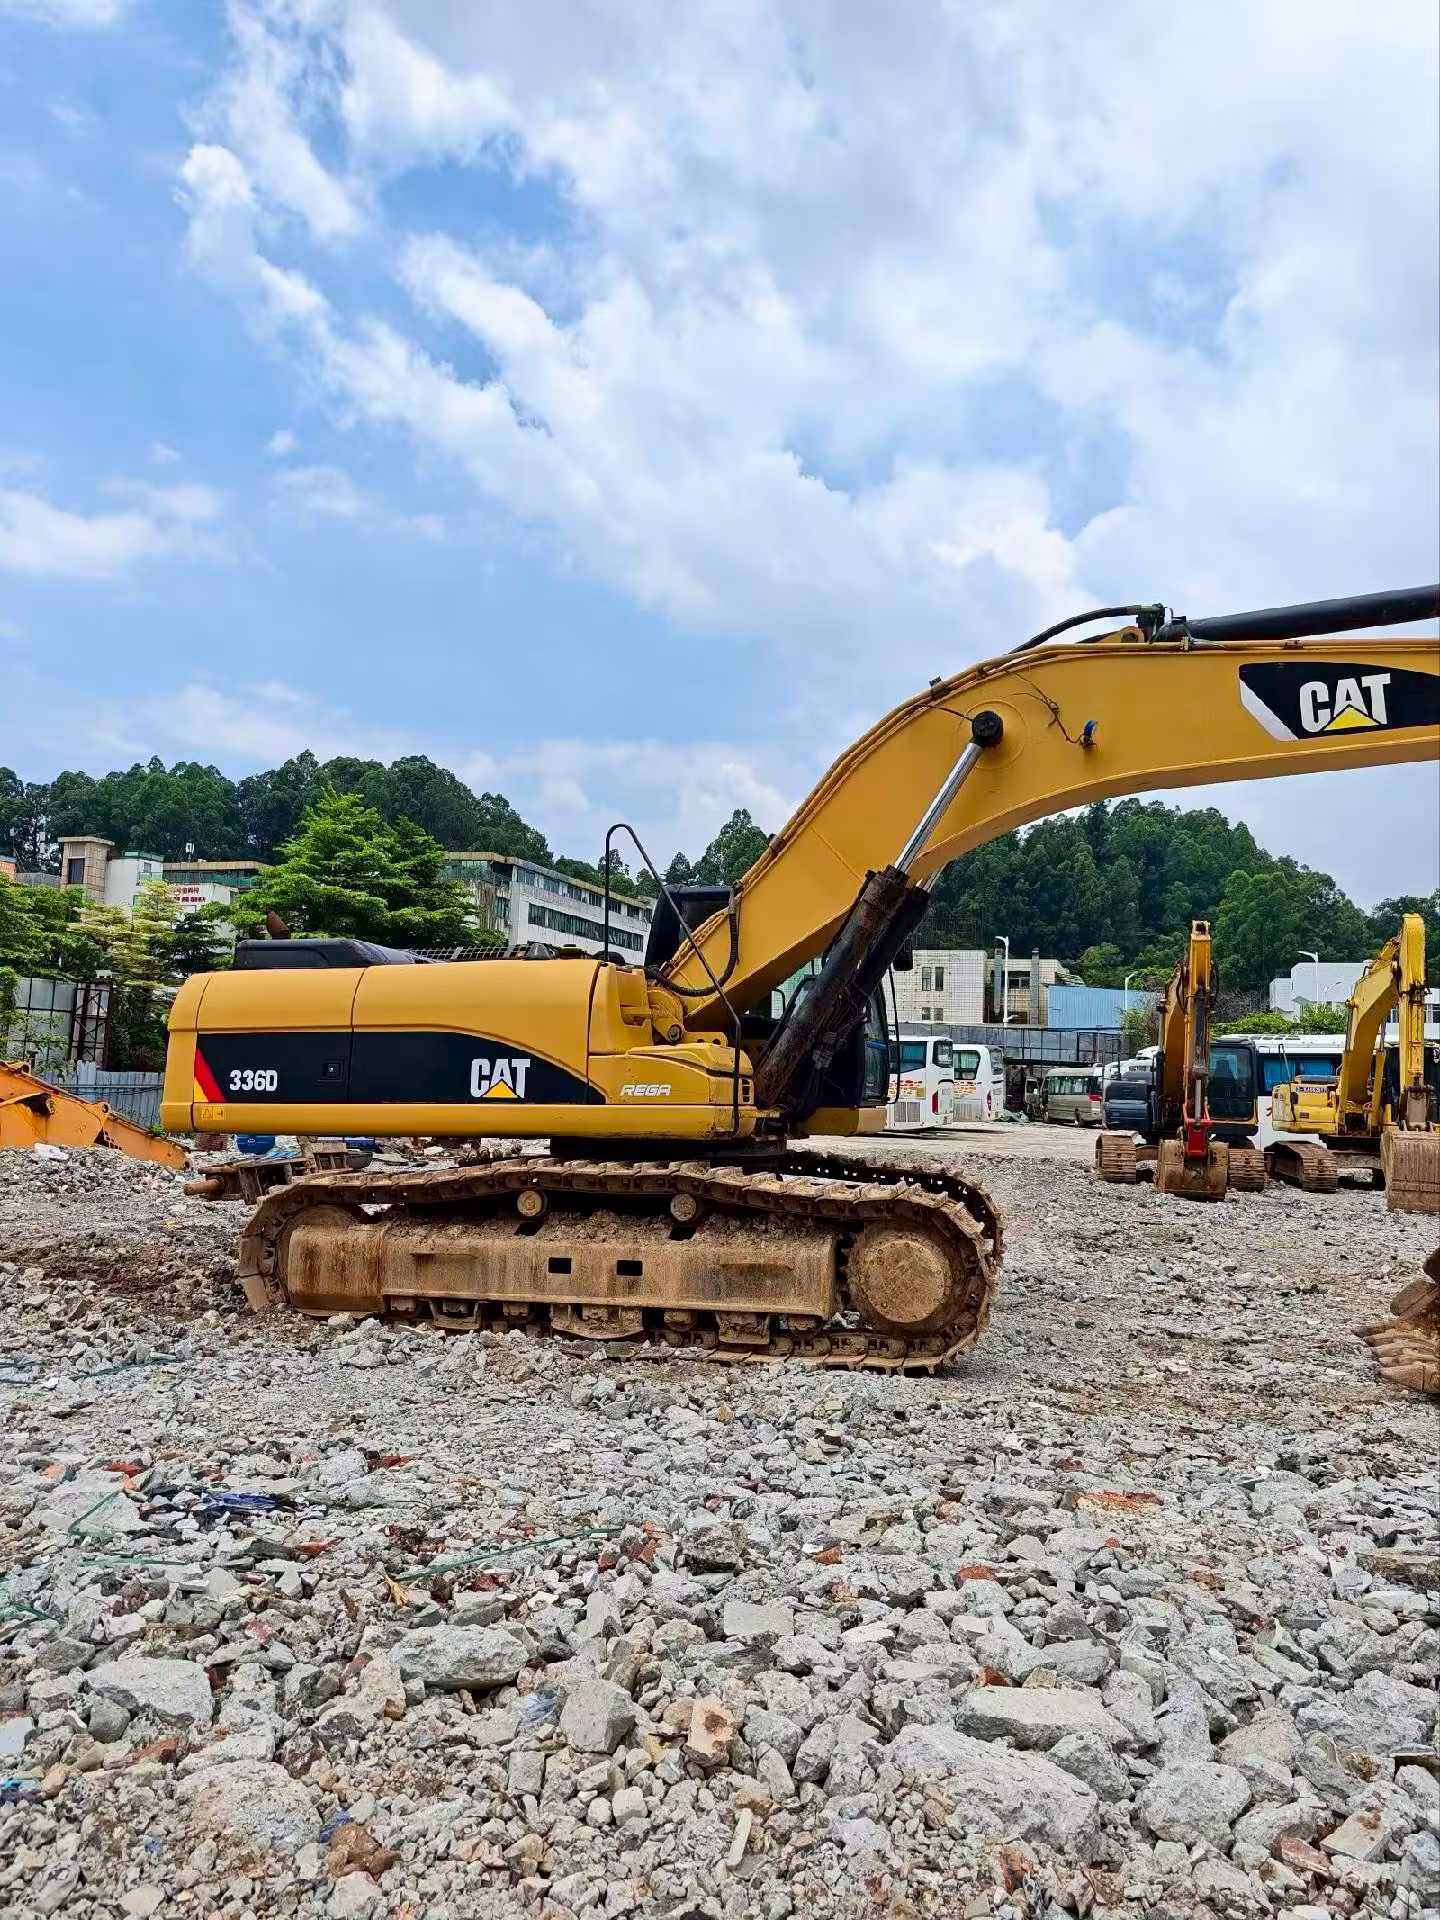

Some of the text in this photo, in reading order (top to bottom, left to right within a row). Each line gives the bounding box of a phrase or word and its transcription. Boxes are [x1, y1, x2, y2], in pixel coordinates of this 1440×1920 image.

[1300, 673, 1391, 733] CAT
[229, 1069, 278, 1092] 336D
[470, 1058, 531, 1099] CAT
